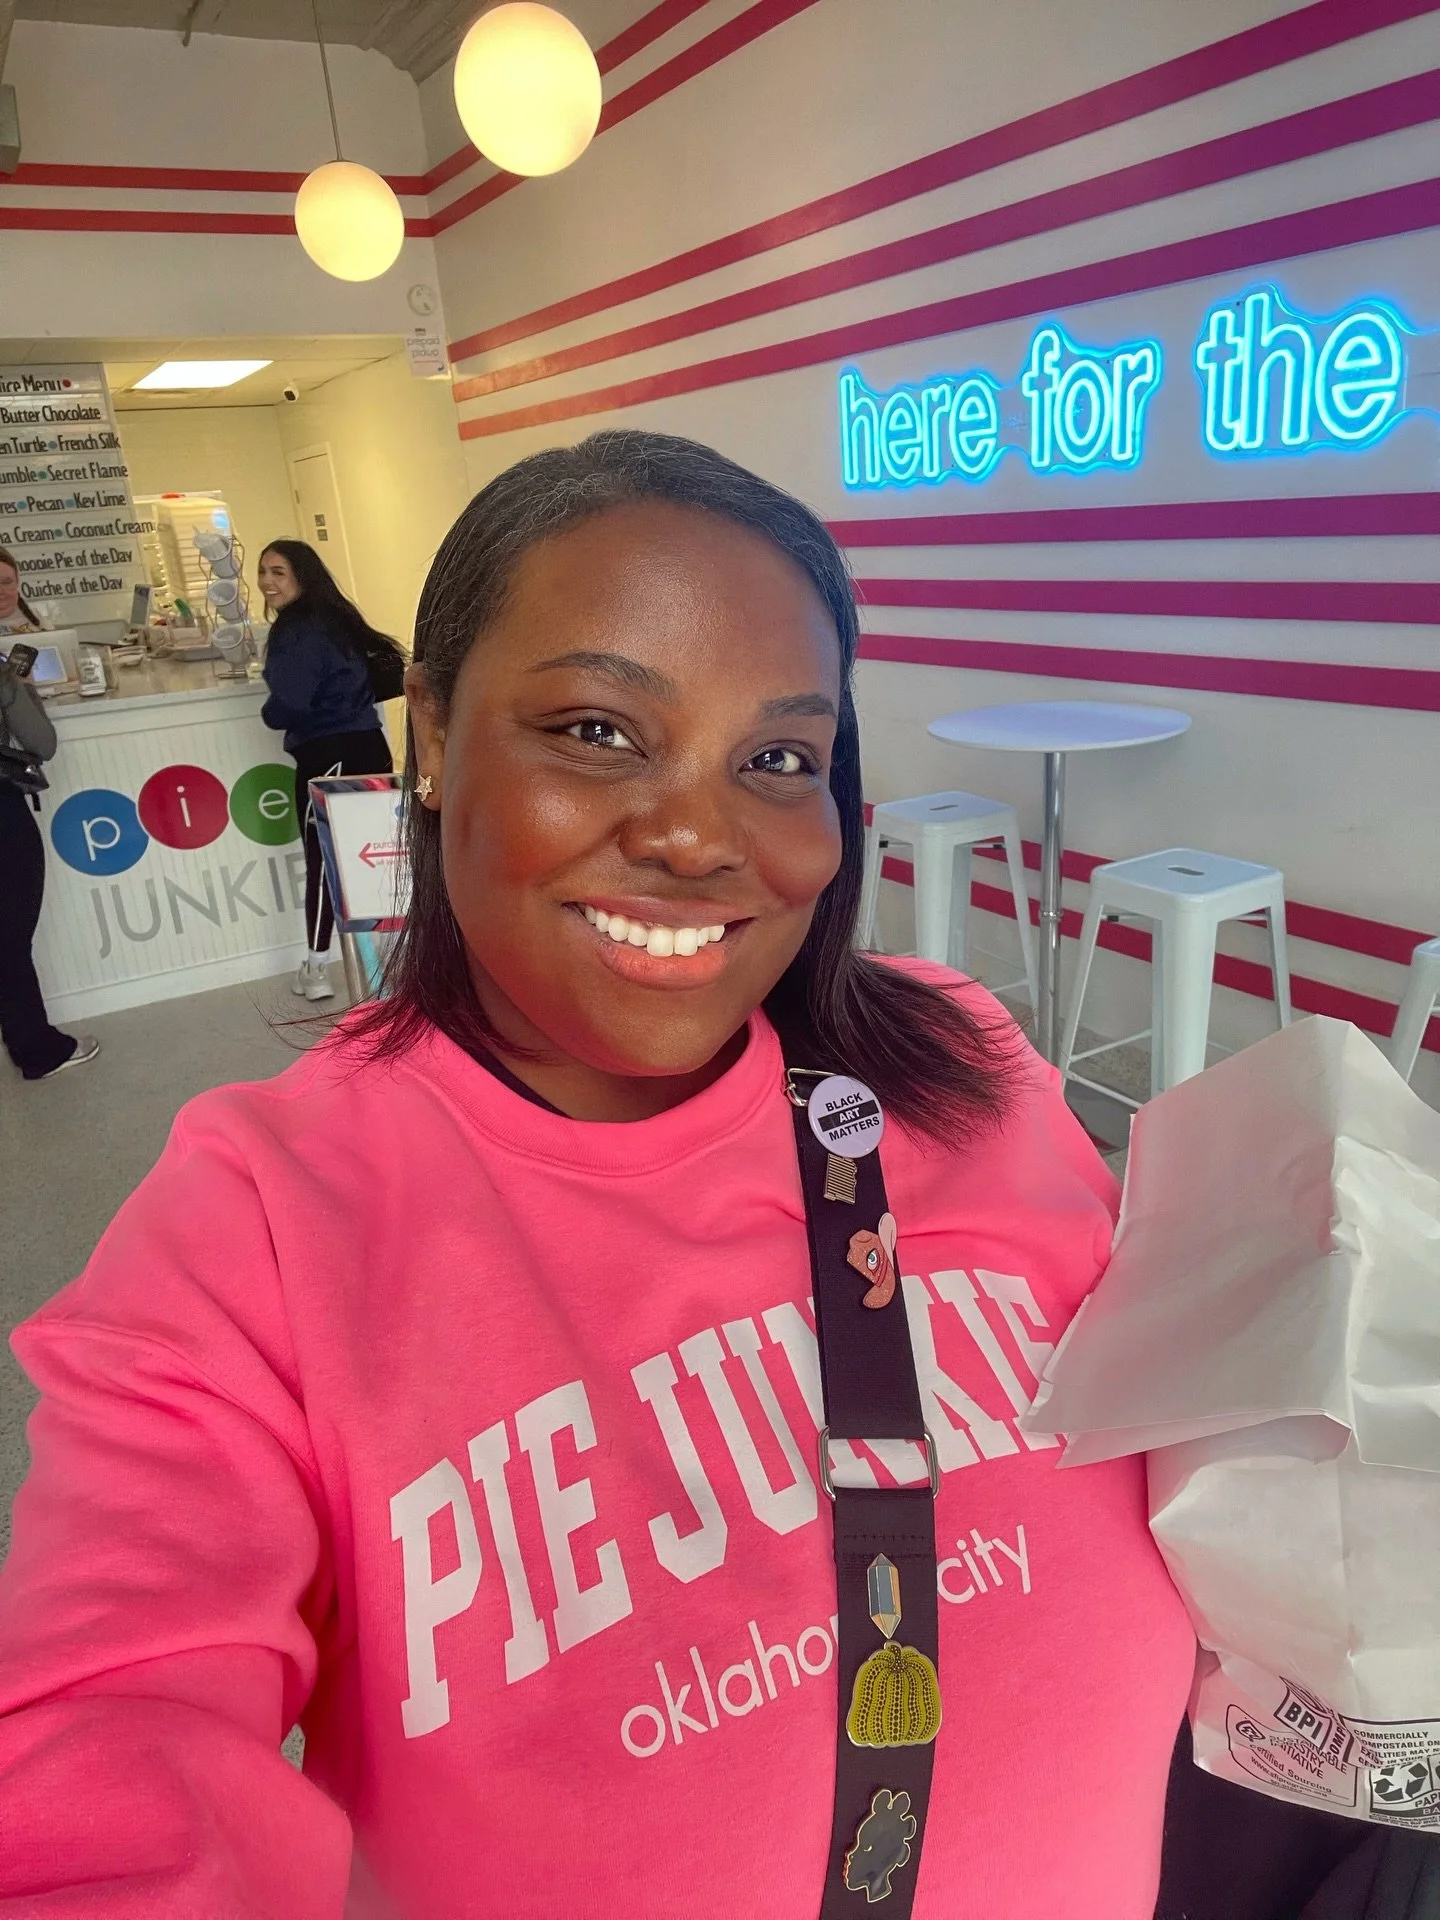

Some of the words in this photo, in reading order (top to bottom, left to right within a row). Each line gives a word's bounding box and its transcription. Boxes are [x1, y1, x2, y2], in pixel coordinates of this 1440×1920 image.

[0, 375, 20, 392] ice
[22, 374, 61, 391] Menu
[840, 374, 998, 484] here
[1022, 329, 1155, 468] for
[1197, 292, 1401, 452] the
[0, 407, 40, 423] Butter
[42, 403, 101, 421] Chocolate
[10, 436, 48, 454] Turtle
[58, 434, 97, 451] French
[98, 432, 121, 448] Silk
[0, 466, 38, 484] umble
[47, 465, 88, 481] Secret
[88, 462, 128, 478] Flame
[26, 495, 65, 512] Pecan
[96, 490, 126, 506] Lime
[14, 525, 54, 542] Cream
[65, 521, 115, 538] Coconut
[115, 518, 153, 534] Cream
[55, 551, 73, 568] Pie
[76, 550, 87, 566] of
[90, 549, 108, 565] the
[109, 547, 132, 564] Day
[21, 579, 62, 598] Quiche
[65, 578, 76, 594] of
[79, 576, 99, 592] the
[100, 575, 122, 590] Day
[82, 785, 290, 862] pie
[90, 852, 306, 959] JUNKIE
[825, 1092, 863, 1112] BLACK
[838, 1107, 861, 1123] ART
[828, 1116, 880, 1141] MATTERS
[390, 1380, 632, 1739] PIE
[619, 1613, 838, 1758] oklaho
[936, 1524, 1032, 1604] city
[1284, 1701, 1323, 1740] BPI
[1354, 1729, 1429, 1740] COMMERCIALLY
[1414, 1791, 1440, 1807] PAP
[1423, 1806, 1440, 1815] BA
